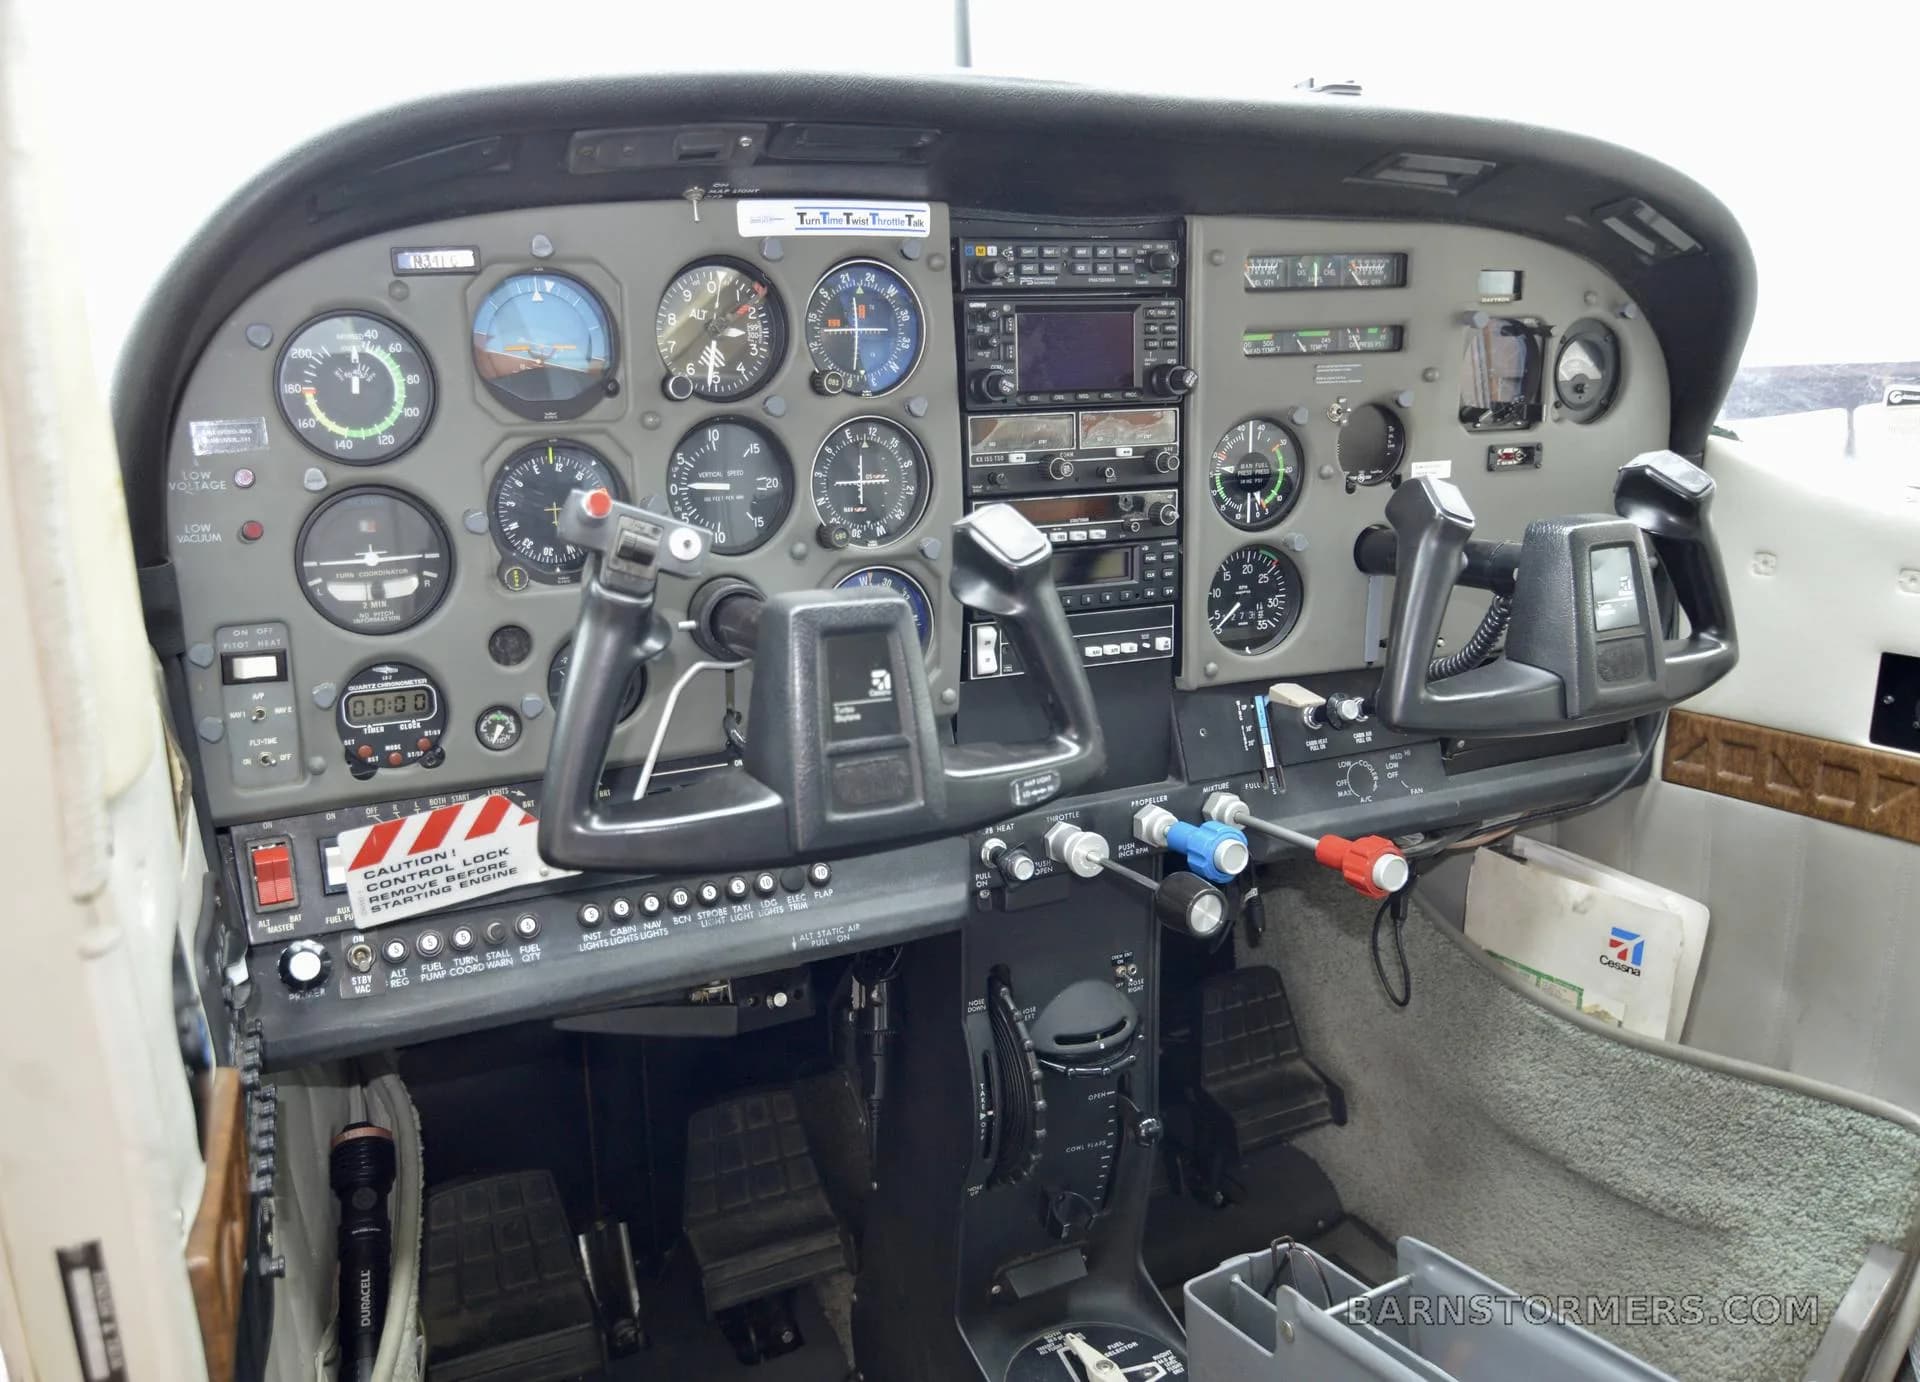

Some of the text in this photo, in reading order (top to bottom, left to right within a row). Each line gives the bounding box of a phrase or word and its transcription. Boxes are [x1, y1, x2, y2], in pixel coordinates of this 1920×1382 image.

[797, 211, 924, 227] Turn Time Twist Throttle Talk
[840, 272, 851, 284] 21
[865, 272, 876, 283] 24
[706, 281, 717, 294] 0
[683, 290, 692, 302] 9
[689, 308, 708, 320] ALT
[748, 307, 757, 319] 2
[667, 313, 677, 326] 8
[364, 329, 378, 340] 40
[388, 343, 402, 353] 60
[667, 341, 677, 353] 7
[750, 344, 758, 356] 3
[291, 348, 313, 359] 200
[686, 363, 696, 375] 6
[736, 362, 746, 375] 4
[406, 374, 420, 385] 80
[284, 384, 301, 394] 180
[403, 407, 420, 417] 100
[298, 418, 316, 429] 160
[708, 429, 720, 441] 10
[868, 427, 878, 437] 12
[335, 440, 353, 450] 140
[377, 435, 395, 445] 120
[750, 443, 761, 454] 15
[677, 453, 685, 465] 5
[183, 471, 211, 481] LOW
[766, 477, 779, 489] 20
[670, 485, 678, 496] 0
[753, 517, 765, 528] 15
[185, 523, 211, 534] LOW
[177, 533, 222, 543] VACUUM
[714, 532, 726, 544] 10
[336, 568, 409, 579] TURN COORDINATOR
[1242, 564, 1253, 574] 20
[1223, 571, 1232, 581] 15
[1258, 573, 1269, 584] 25
[1212, 588, 1222, 598] 10
[1267, 598, 1279, 608] 30
[1256, 620, 1268, 630] 35
[232, 629, 249, 637] ON
[257, 638, 281, 647] HEAT
[348, 678, 427, 691] QUARTZ CHRONOMETER
[364, 726, 384, 734] TIMER
[400, 722, 421, 730] CLOCK
[1386, 762, 1399, 770] LOW
[1387, 771, 1399, 779] OFF
[487, 788, 509, 797] LIGHTS
[1203, 782, 1229, 793] MIXTURE
[429, 798, 447, 806] BOTH
[451, 794, 470, 803] START
[1131, 795, 1168, 807] PROPELLER
[326, 812, 336, 821] ON
[366, 807, 379, 815] OFF
[1046, 811, 1080, 823] THROTTLE
[1118, 842, 1135, 851] PUSH
[1136, 846, 1149, 855] RPM
[367, 847, 510, 893] CONTROL LOCK
[1035, 866, 1053, 876] OPEN
[369, 860, 508, 904] REMOVE BEFORE
[976, 872, 991, 881] PULL
[976, 880, 988, 888] ON
[371, 867, 518, 913] STARTING ENGINE
[814, 888, 834, 899] FLAP
[760, 899, 778, 908] LDG
[787, 893, 806, 904] ELEC
[337, 906, 350, 915] AUX
[759, 906, 784, 918] LIGHTS
[789, 902, 808, 912] TRIM
[289, 914, 302, 923] BAT
[672, 915, 692, 925] BCN
[730, 911, 754, 923] LIGHT
[258, 919, 270, 928] ALT
[267, 923, 295, 934] MASTER
[643, 920, 662, 930] NAV
[609, 925, 637, 937] CABIN
[640, 928, 669, 940] LIGHTS
[799, 923, 861, 941] ALT STATIC AIR
[582, 932, 602, 942] INST
[610, 934, 639, 946] LIGHTS
[811, 933, 850, 947] PULL ON
[519, 944, 541, 954] FUEL
[579, 939, 609, 952] LIGHTS
[453, 955, 479, 966] TURN
[485, 950, 511, 961] STALL
[522, 952, 541, 963] QTY
[421, 962, 444, 973] FUEL
[486, 959, 514, 970] WARN
[1599, 955, 1641, 977] Cessna
[391, 968, 407, 978] ALT
[450, 964, 485, 977] COORD
[352, 975, 372, 985] STBY
[421, 971, 447, 982] PUMP
[355, 984, 371, 993] VAC
[391, 979, 410, 988] REG
[1128, 985, 1144, 994] RIGHT
[968, 999, 985, 1008] NOSE
[1088, 1091, 1107, 1101] OPEN
[1066, 1140, 1107, 1153] COWL FLAPS
[360, 1269, 371, 1328] DURACELL
[1107, 1341, 1125, 1350] FUEL
